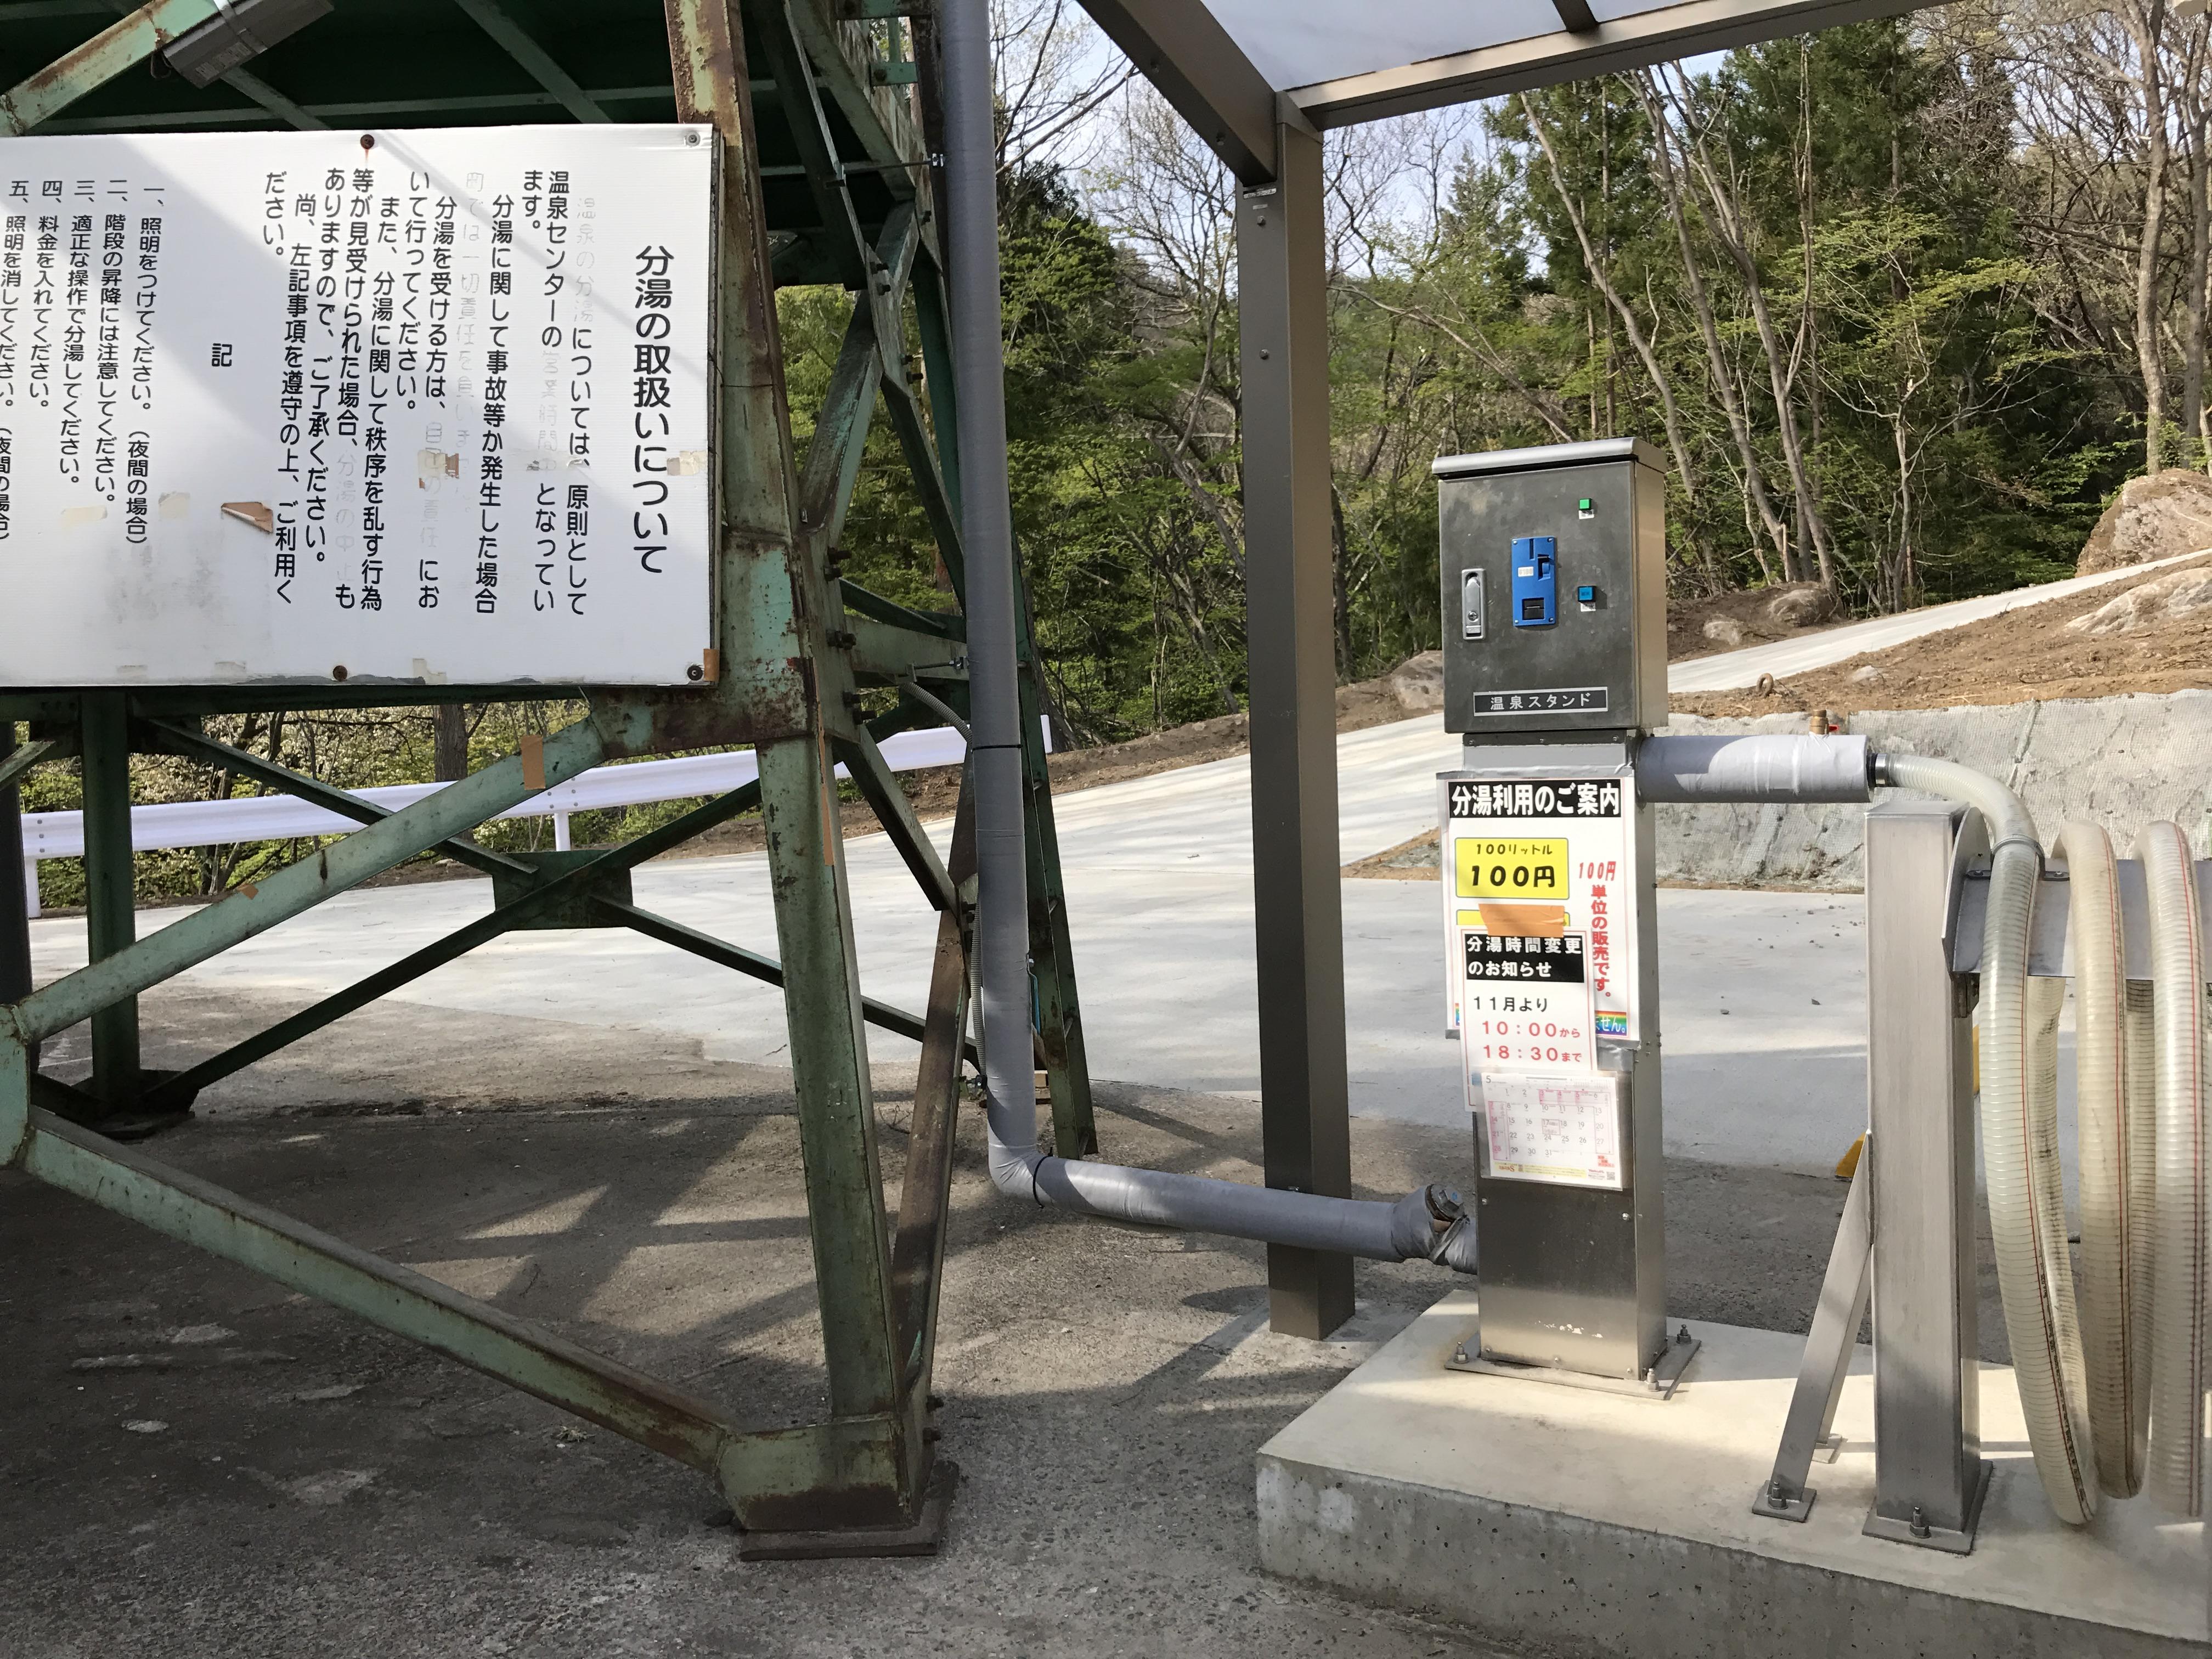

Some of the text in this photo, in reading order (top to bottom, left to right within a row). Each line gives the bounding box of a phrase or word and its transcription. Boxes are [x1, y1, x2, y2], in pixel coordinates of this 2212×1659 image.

[263, 171, 287, 256] ださい。
[521, 170, 543, 229] ます。
[396, 171, 430, 410] いて行ってください。
[211, 342, 233, 368] 記
[305, 167, 345, 562] ありますので、ご了承ください。
[633, 245, 674, 573] 分湯の取扱いについて
[1490, 693, 1592, 711] 温泉スタンド
[1451, 782, 1620, 816] 分湯利用のご案内
[1476, 843, 1553, 856] 100リットル
[1471, 865, 1555, 888] 100円
[1579, 860, 1617, 882] 100円
[1466, 936, 1582, 955] 分湯時間変更
[1591, 884, 1611, 998] 単位の販売です。
[1468, 961, 1552, 978] のお知らせ
